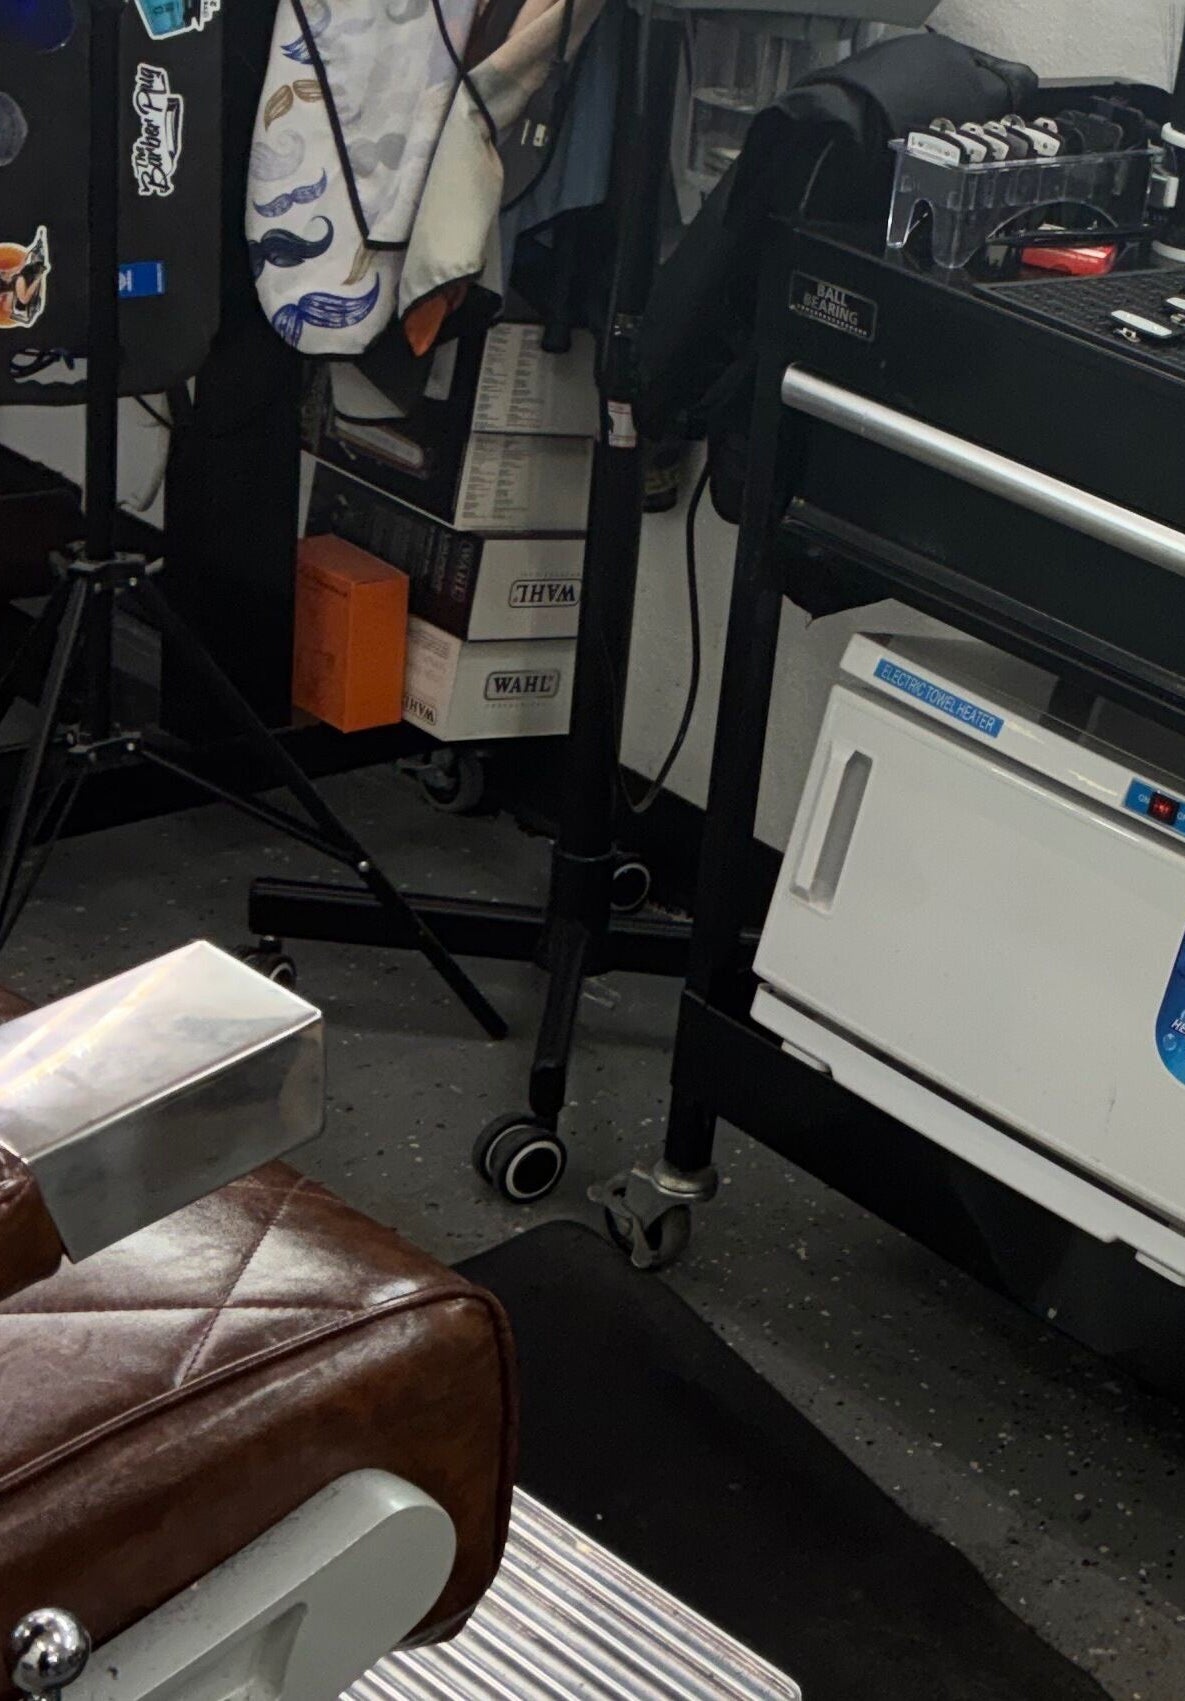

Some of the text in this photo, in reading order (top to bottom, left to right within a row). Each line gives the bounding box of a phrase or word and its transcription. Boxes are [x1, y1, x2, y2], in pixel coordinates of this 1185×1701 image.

[817, 280, 848, 308] BALL
[804, 291, 859, 326] BEARING
[516, 583, 576, 603] WAHL
[493, 675, 552, 694] WAHL
[881, 663, 997, 732] ELECTRIC TOWEL HEATER
